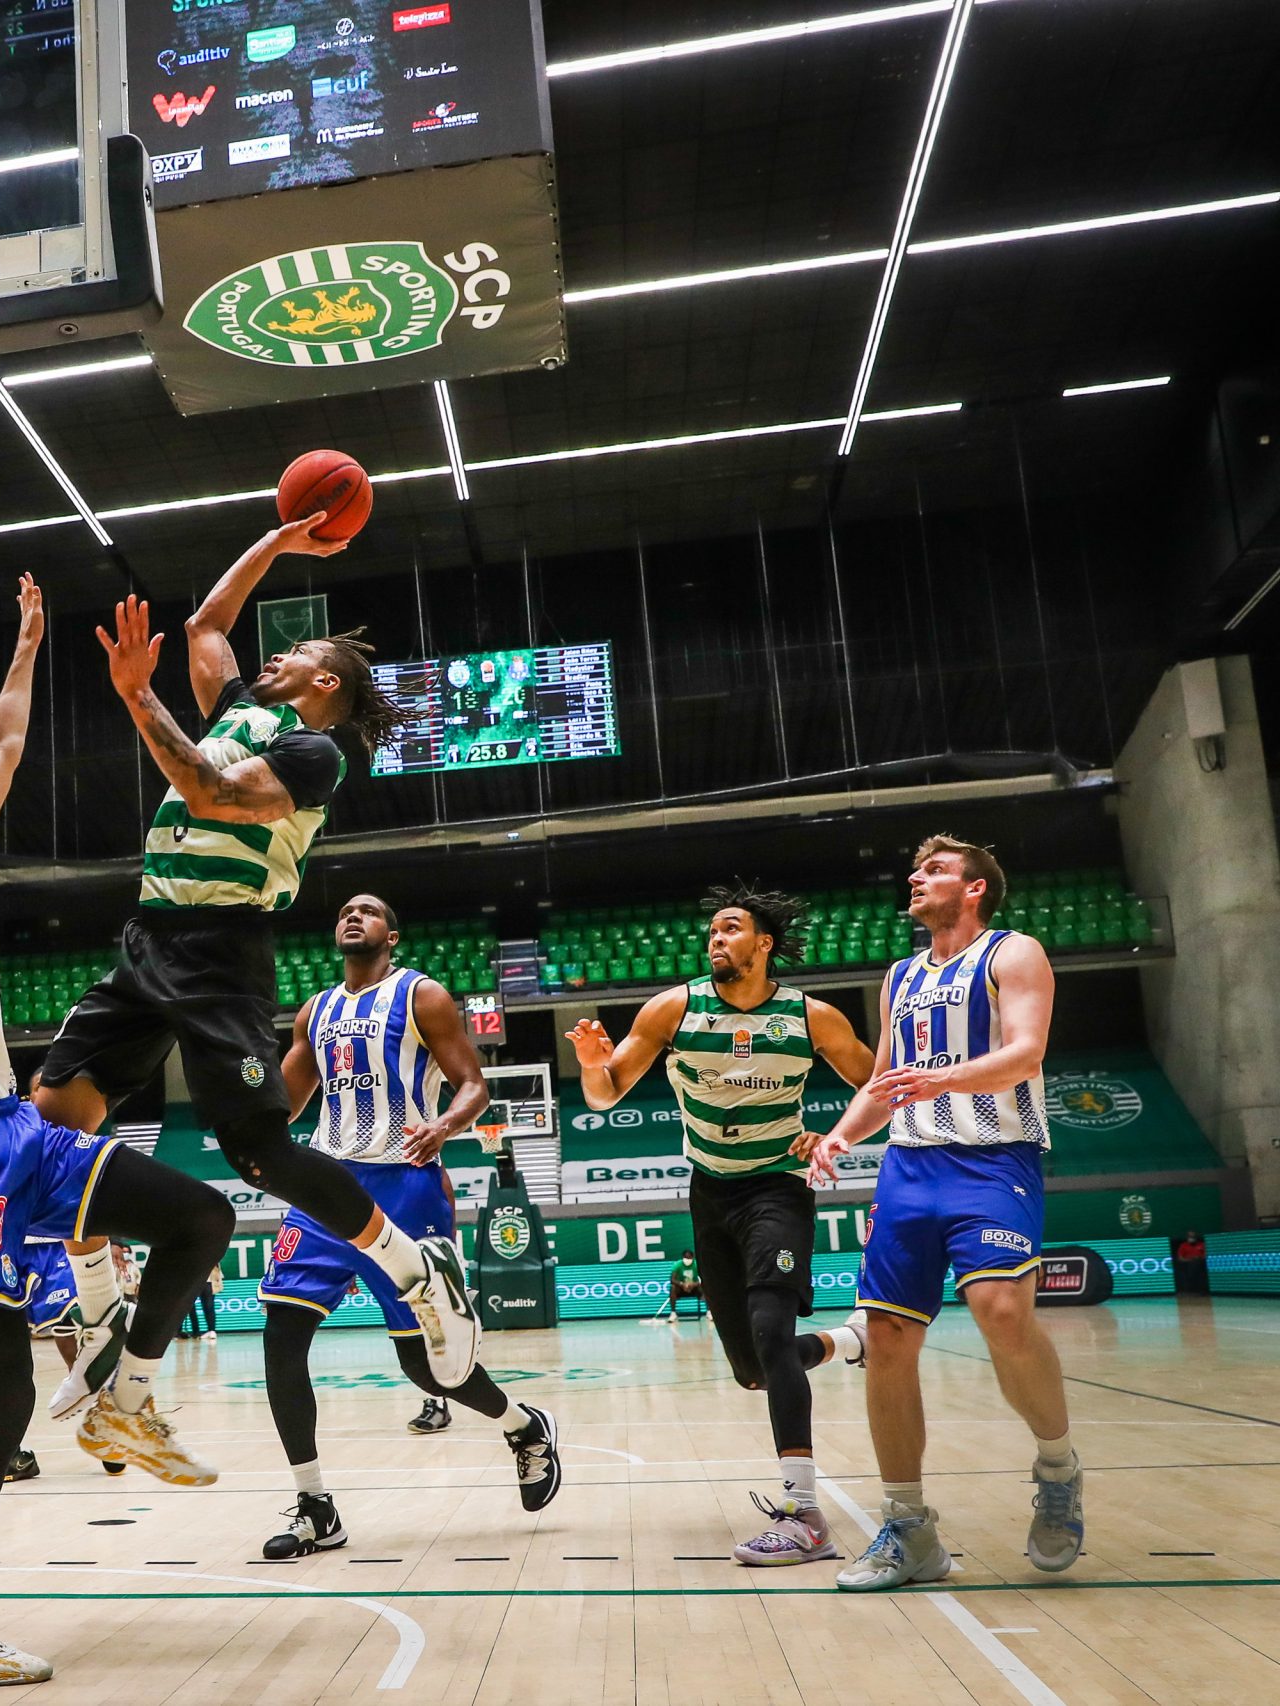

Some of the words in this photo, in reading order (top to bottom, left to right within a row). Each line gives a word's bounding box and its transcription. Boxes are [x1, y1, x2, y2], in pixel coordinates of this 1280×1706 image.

[179, 46, 230, 66] auditiv
[333, 70, 369, 94] cuf
[235, 88, 294, 109] macron
[443, 242, 511, 330] SCP
[360, 255, 437, 350] SPORTING
[217, 280, 275, 360] PORTUGAL
[470, 744, 507, 761] 25.8
[471, 1011, 501, 1035] 12
[916, 1021, 928, 1052] 5
[332, 1043, 355, 1073] 29
[724, 1076, 782, 1090] auditiv
[494, 1206, 523, 1218] SCP
[597, 1220, 665, 1262] DE
[984, 1231, 1029, 1248] BOXPT
[1047, 1264, 1068, 1274] LIGA
[503, 1298, 537, 1308] auditiv
